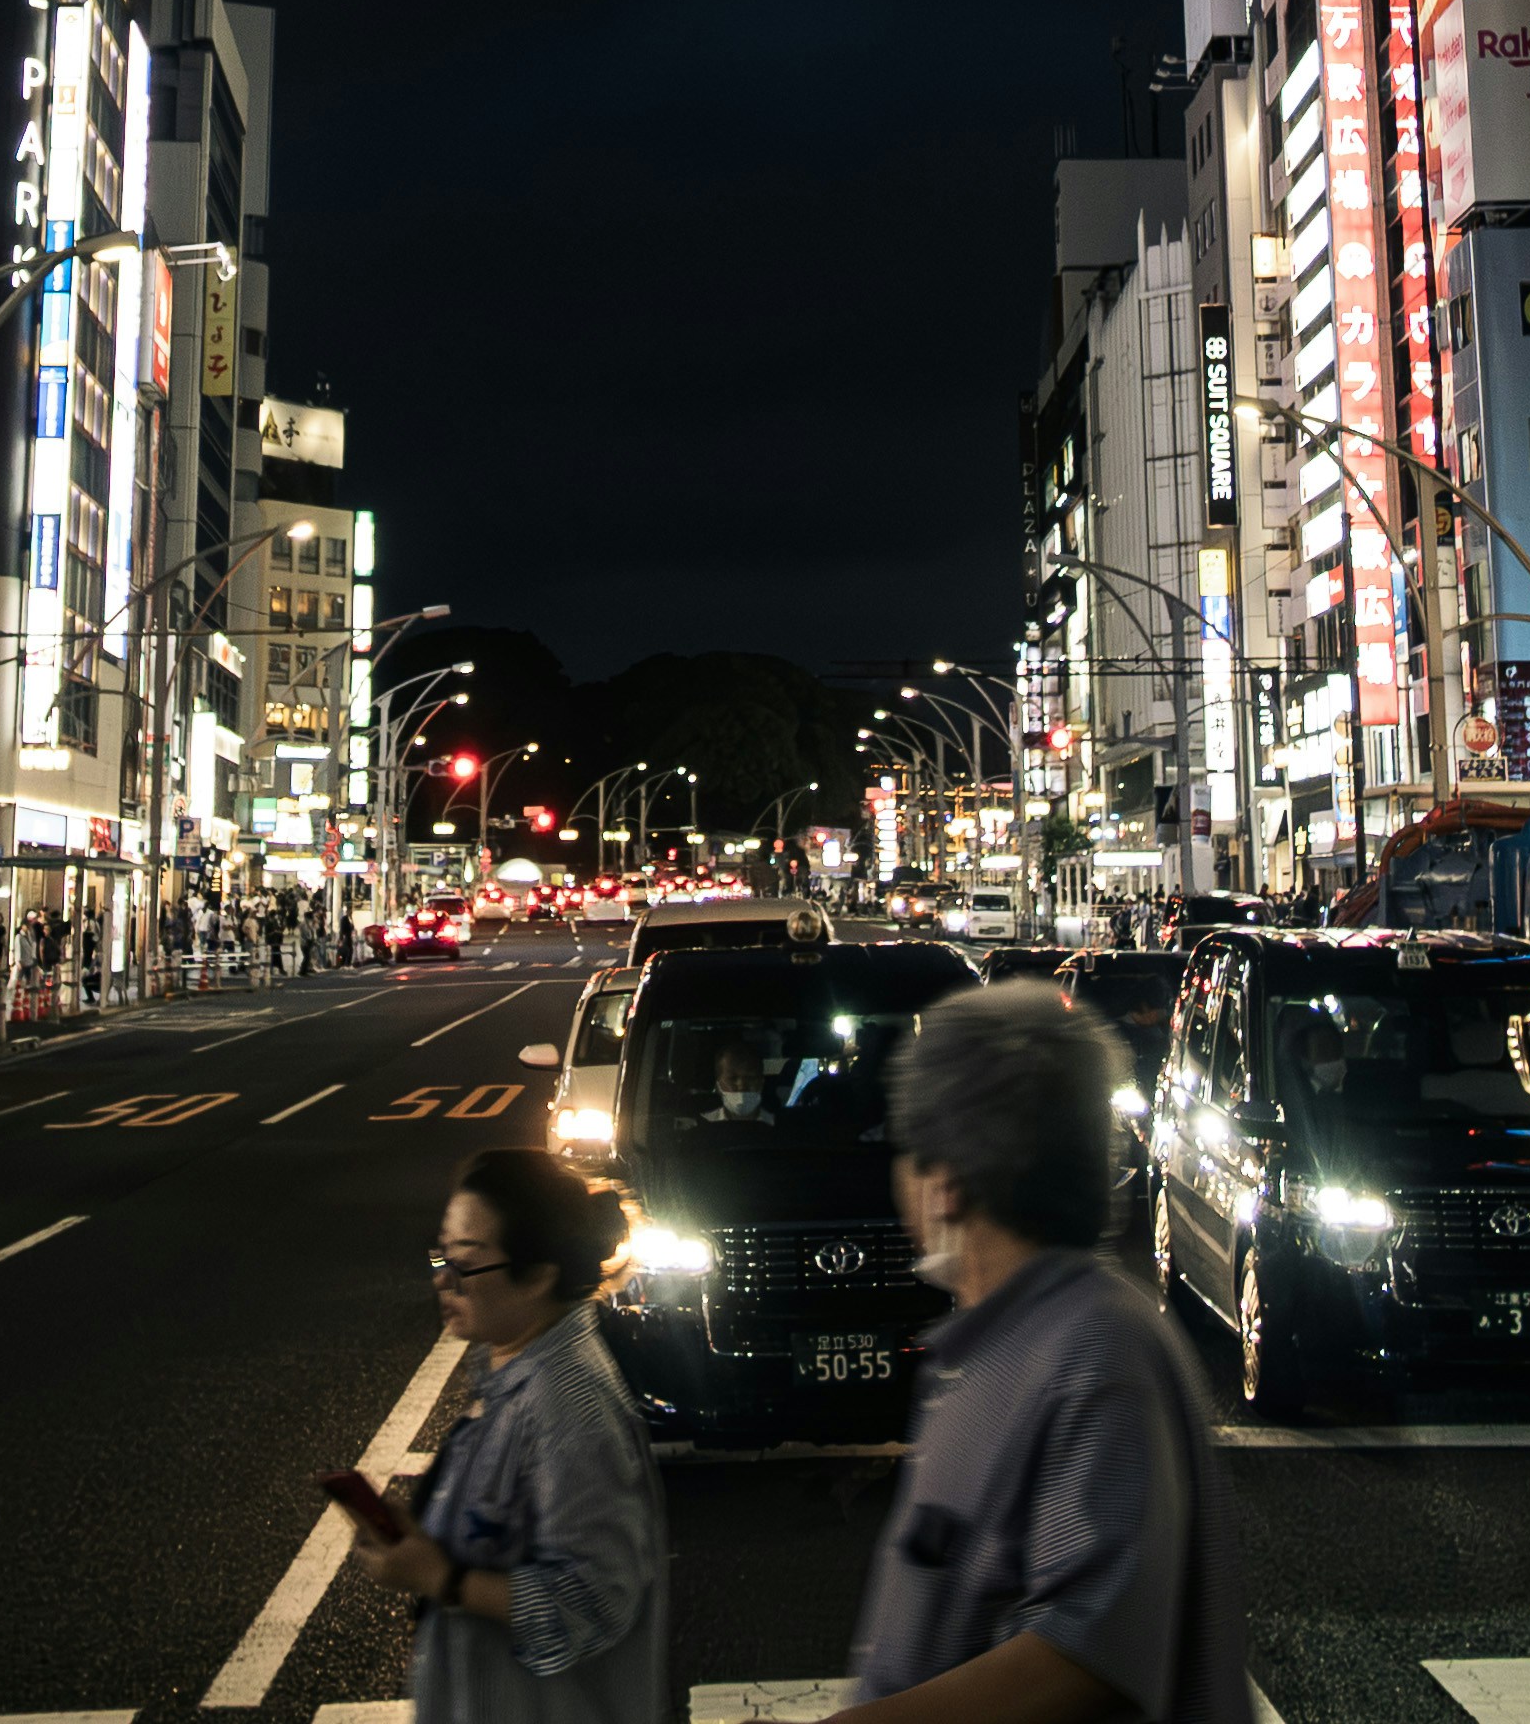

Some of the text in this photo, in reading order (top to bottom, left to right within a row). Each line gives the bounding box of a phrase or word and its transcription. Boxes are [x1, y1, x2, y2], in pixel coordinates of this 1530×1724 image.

[11, 56, 45, 288] PARK
[1206, 363, 1231, 501] SUIT SQUARE
[42, 1092, 240, 1129] 50
[367, 1084, 527, 1121] 50
[817, 1334, 874, 1351] 足立 530
[816, 1351, 892, 1381] 50-55
